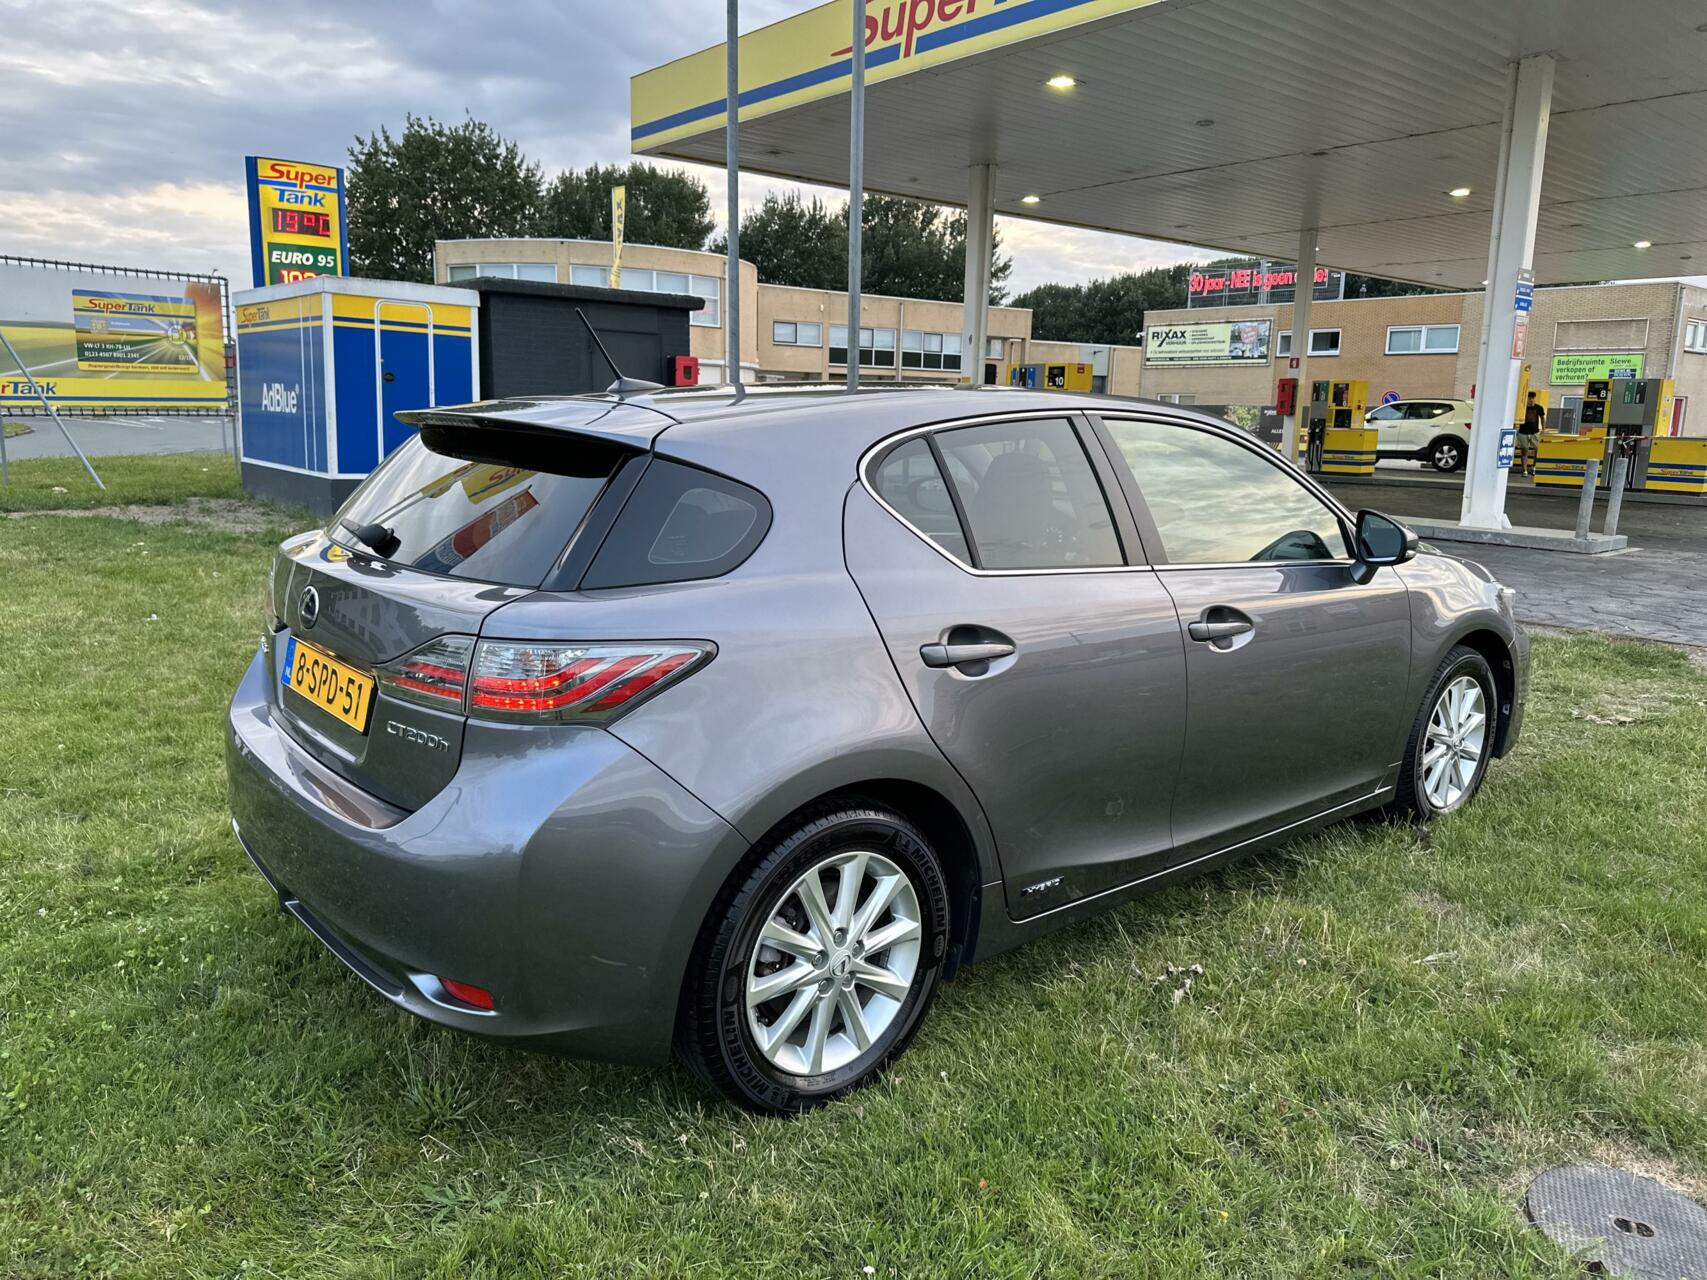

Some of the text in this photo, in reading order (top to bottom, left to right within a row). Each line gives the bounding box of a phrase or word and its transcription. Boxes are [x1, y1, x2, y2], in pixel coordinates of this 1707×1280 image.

[259, 162, 336, 189] Super
[272, 187, 325, 207] Tank
[271, 250, 335, 267] EURO 95
[1231, 270, 1250, 288] NEE
[83, 298, 156, 314] SuperTank
[1151, 329, 1187, 347] RIXAX
[1557, 358, 1605, 367] Bedrijfsruimte
[1055, 376, 1064, 386] 10
[1555, 373, 1589, 381] verhuren?
[1600, 390, 1607, 398] 8
[296, 651, 363, 720] 8-SPD-51
[386, 719, 451, 752] CT200h
